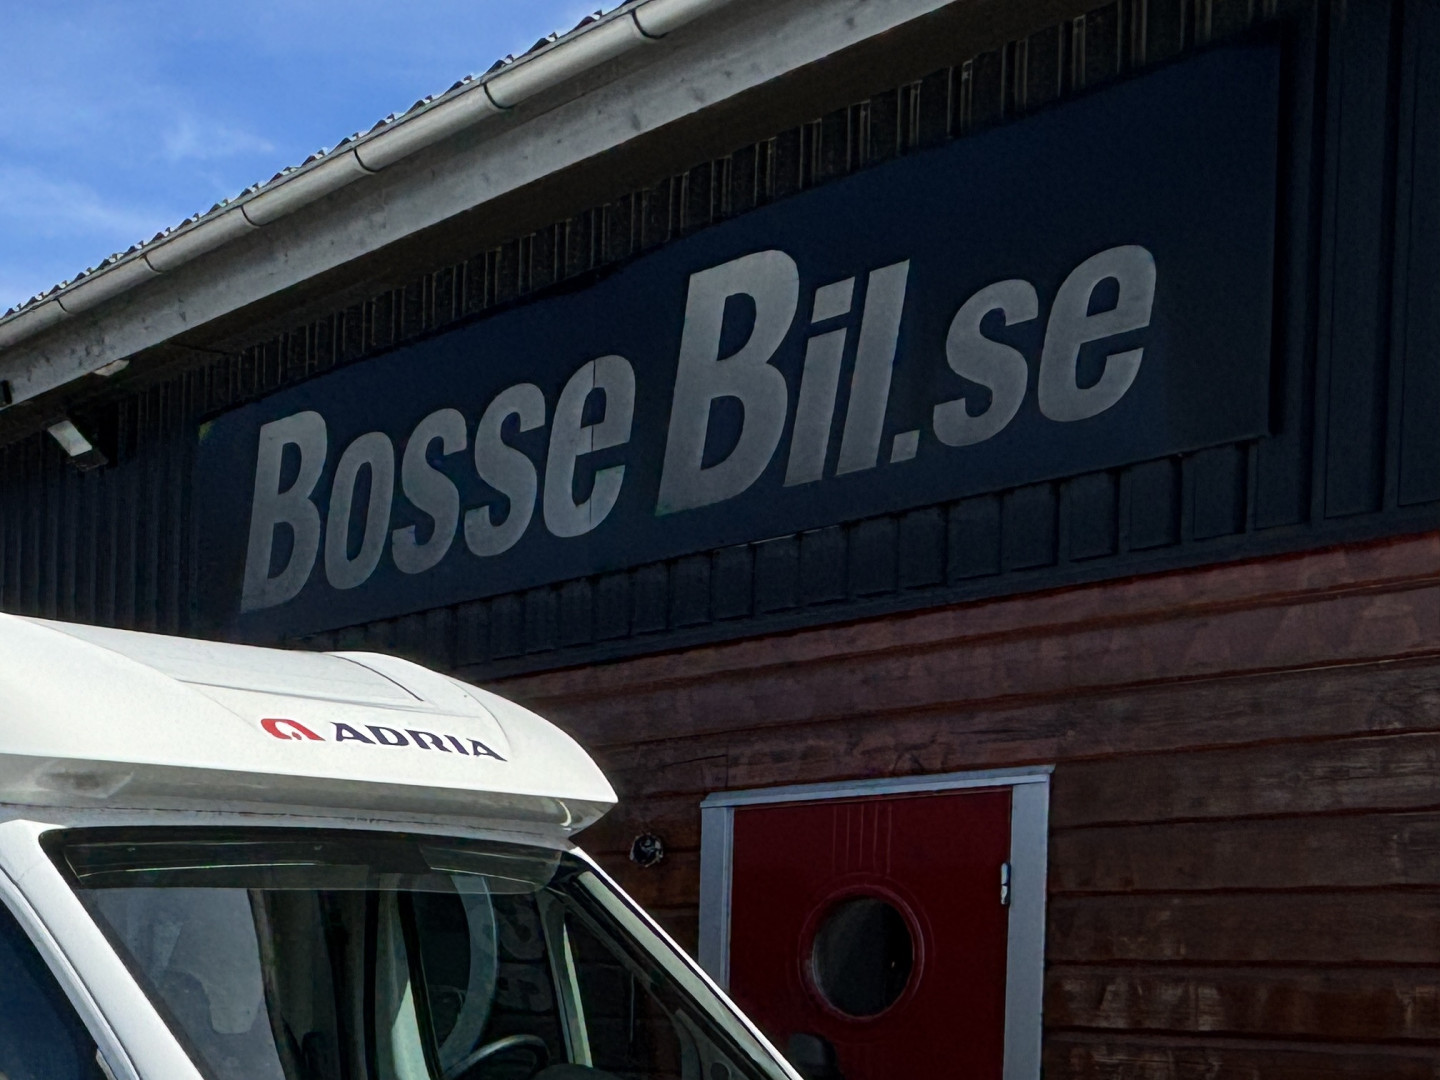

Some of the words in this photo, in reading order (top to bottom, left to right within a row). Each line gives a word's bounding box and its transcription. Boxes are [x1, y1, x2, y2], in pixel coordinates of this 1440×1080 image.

[240, 354, 637, 612] Bosse
[655, 244, 1159, 516] Bil.se
[330, 721, 508, 762] ADRIA
